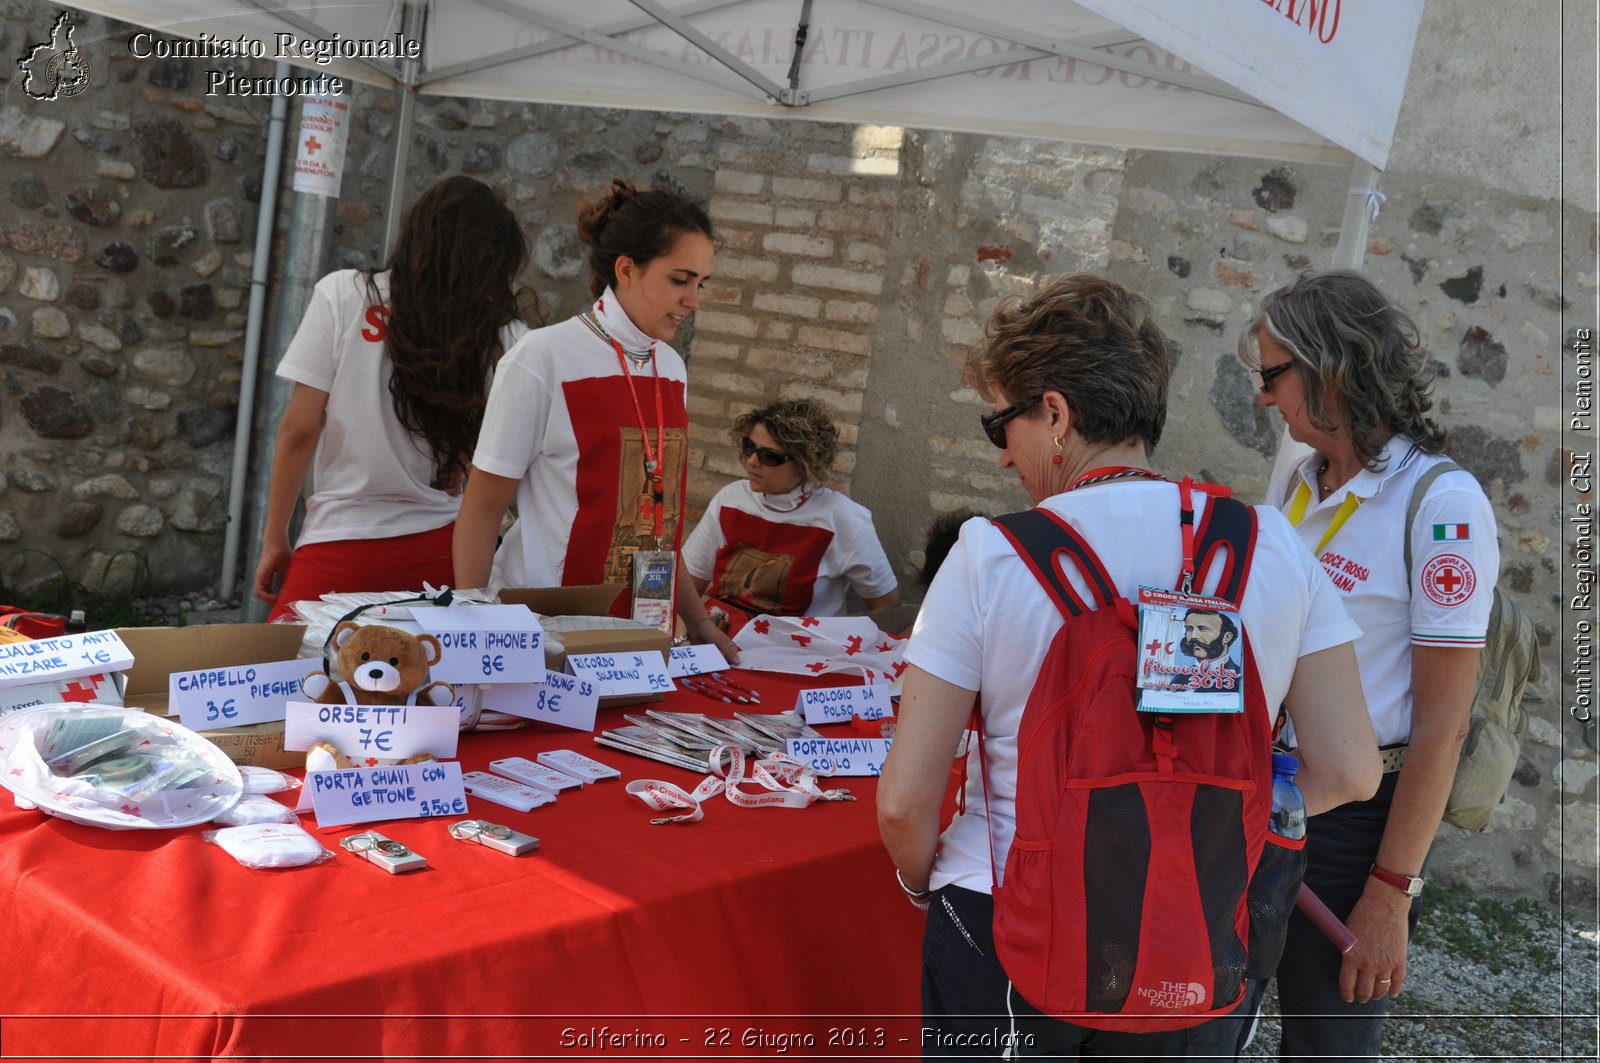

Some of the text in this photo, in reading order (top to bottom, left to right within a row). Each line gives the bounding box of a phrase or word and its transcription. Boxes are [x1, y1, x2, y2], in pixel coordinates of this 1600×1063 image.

[1342, 560, 1371, 583] ROSSA
[1153, 592, 1238, 610] CROCE ROSSA ITALIANA
[82, 632, 118, 646] ANTI
[531, 632, 541, 650] 5
[81, 650, 111, 665] 1€
[481, 654, 505, 676] 8€
[574, 655, 645, 671] RICORDO DI
[178, 668, 257, 692] CAPPELLO
[595, 668, 670, 691] SOLFERINO 5€
[1188, 675, 1236, 690] 2013
[579, 681, 593, 697] S3
[806, 687, 875, 705] OROLOGIO DA
[536, 690, 563, 713] 8€
[206, 699, 240, 723] 3€
[318, 706, 408, 725] ORSETTI
[823, 704, 854, 718] POLSO
[358, 728, 395, 752] 7€
[793, 739, 874, 757] PORTACHIAVI
[313, 766, 447, 792] PORTA CHIAVI CON
[350, 786, 417, 808] GETTONE
[734, 794, 758, 806] Rossa
[1138, 987, 1188, 1003] NORTH
[1160, 981, 1188, 993] THE
[1150, 999, 1184, 1009] FACE
